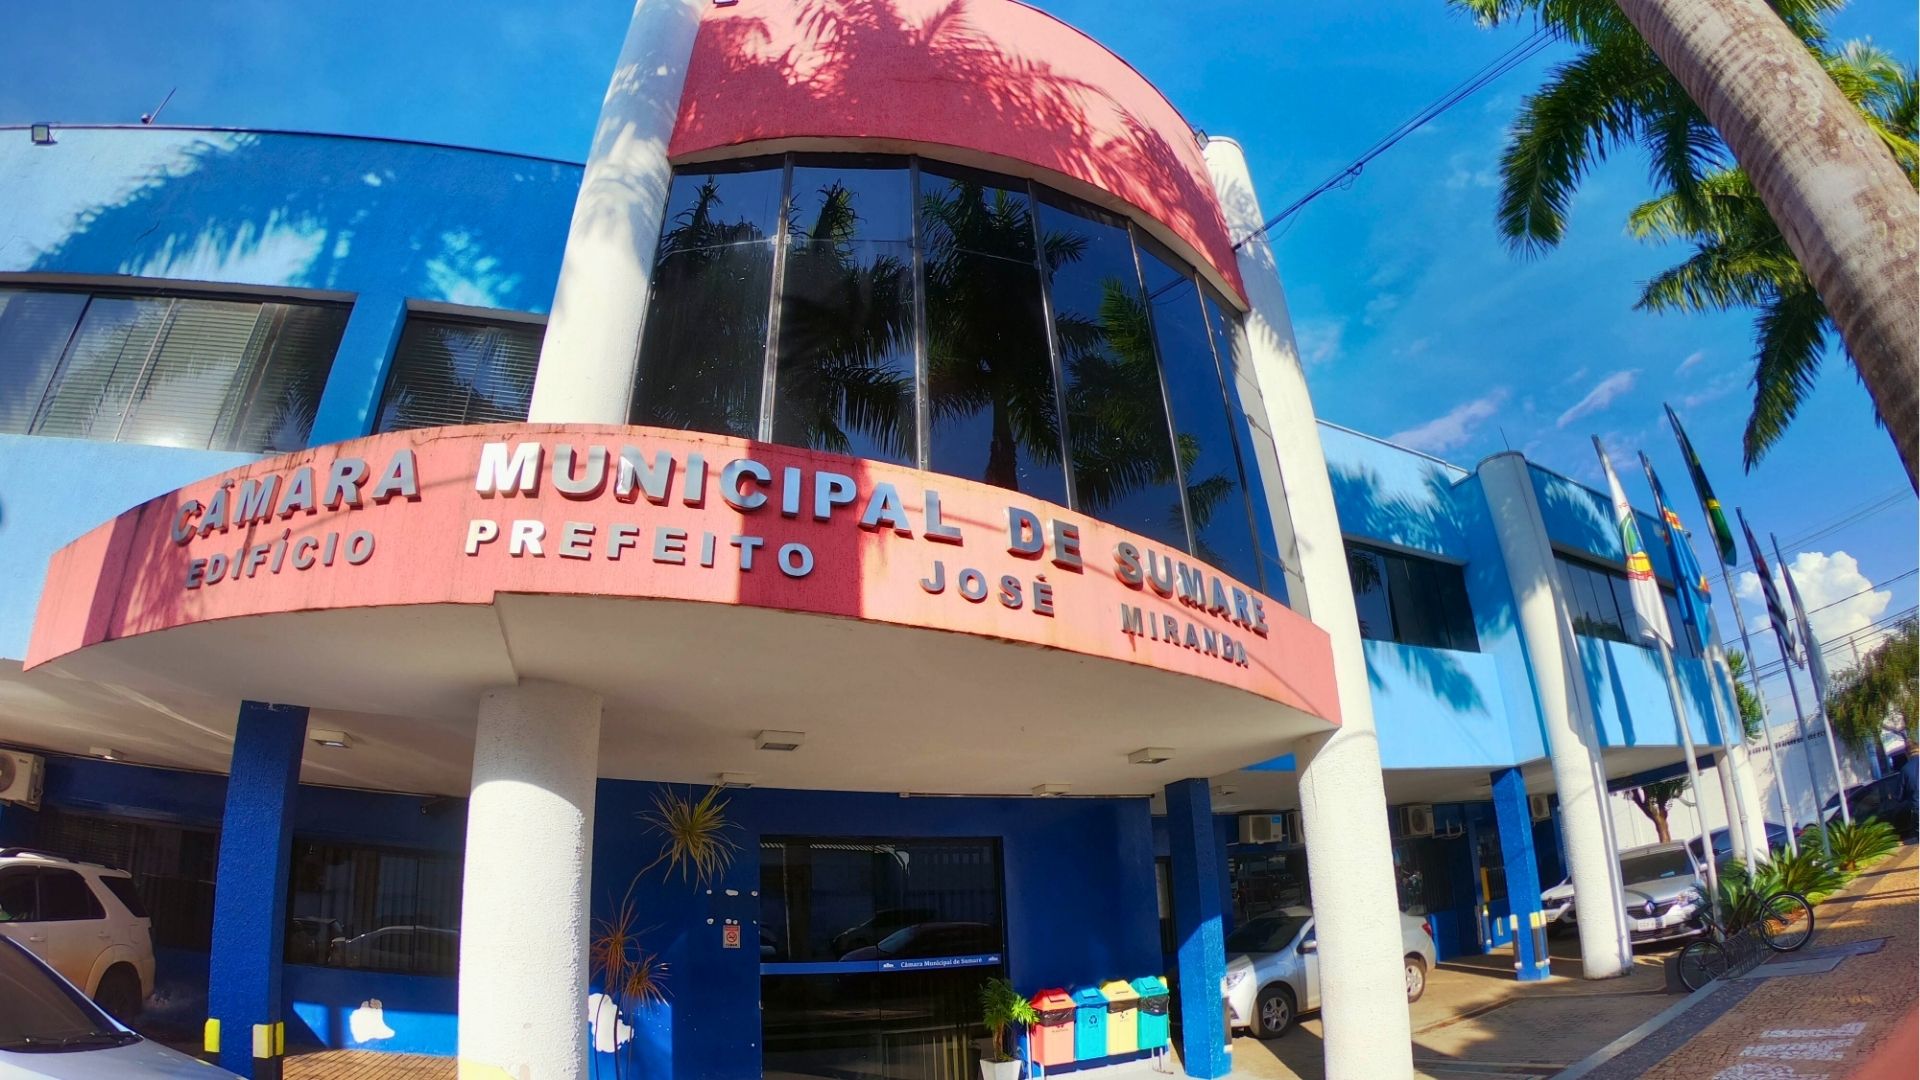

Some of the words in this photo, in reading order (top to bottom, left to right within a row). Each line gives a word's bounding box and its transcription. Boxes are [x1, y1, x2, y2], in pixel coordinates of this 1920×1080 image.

[171, 449, 421, 547] CÂMARA
[475, 442, 963, 547] MUNICIPAL
[1003, 506, 1083, 574] DE
[1113, 541, 1269, 640] SUMARE
[186, 528, 376, 589] EDIFÍCIO
[465, 519, 814, 577] PREFEITO
[919, 560, 1054, 617] JOSÉ
[1120, 603, 1249, 668] MIRANDA
[924, 959, 952, 967] Municipal
